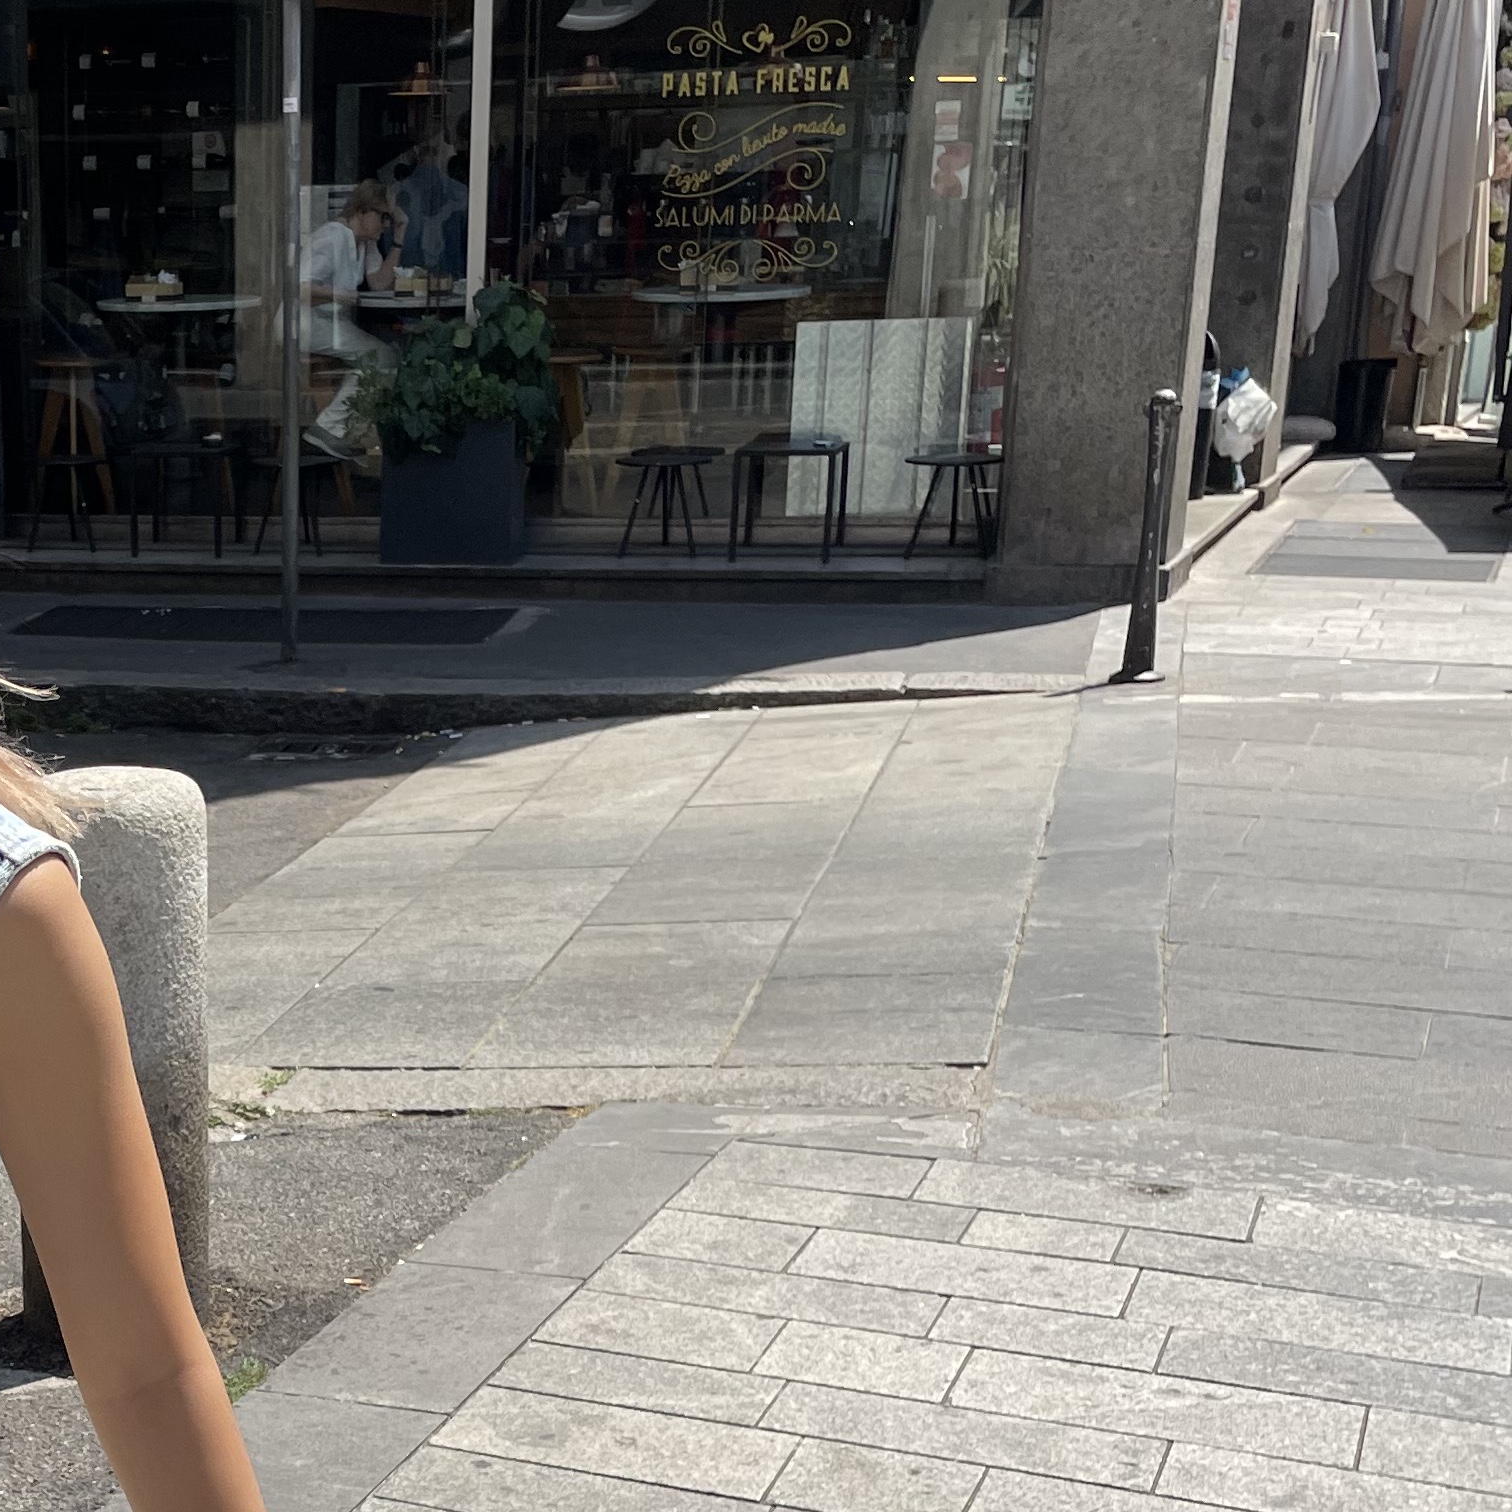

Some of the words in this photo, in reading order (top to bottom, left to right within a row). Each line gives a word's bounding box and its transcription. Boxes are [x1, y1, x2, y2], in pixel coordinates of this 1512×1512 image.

[661, 70, 738, 98] PASTA
[755, 65, 849, 94] FRESCA
[663, 164, 711, 194] Pizza
[714, 153, 740, 175] con
[792, 113, 846, 136] madre
[654, 200, 734, 227] SALUMI
[740, 204, 756, 225] DI
[762, 202, 841, 224] PARMA
